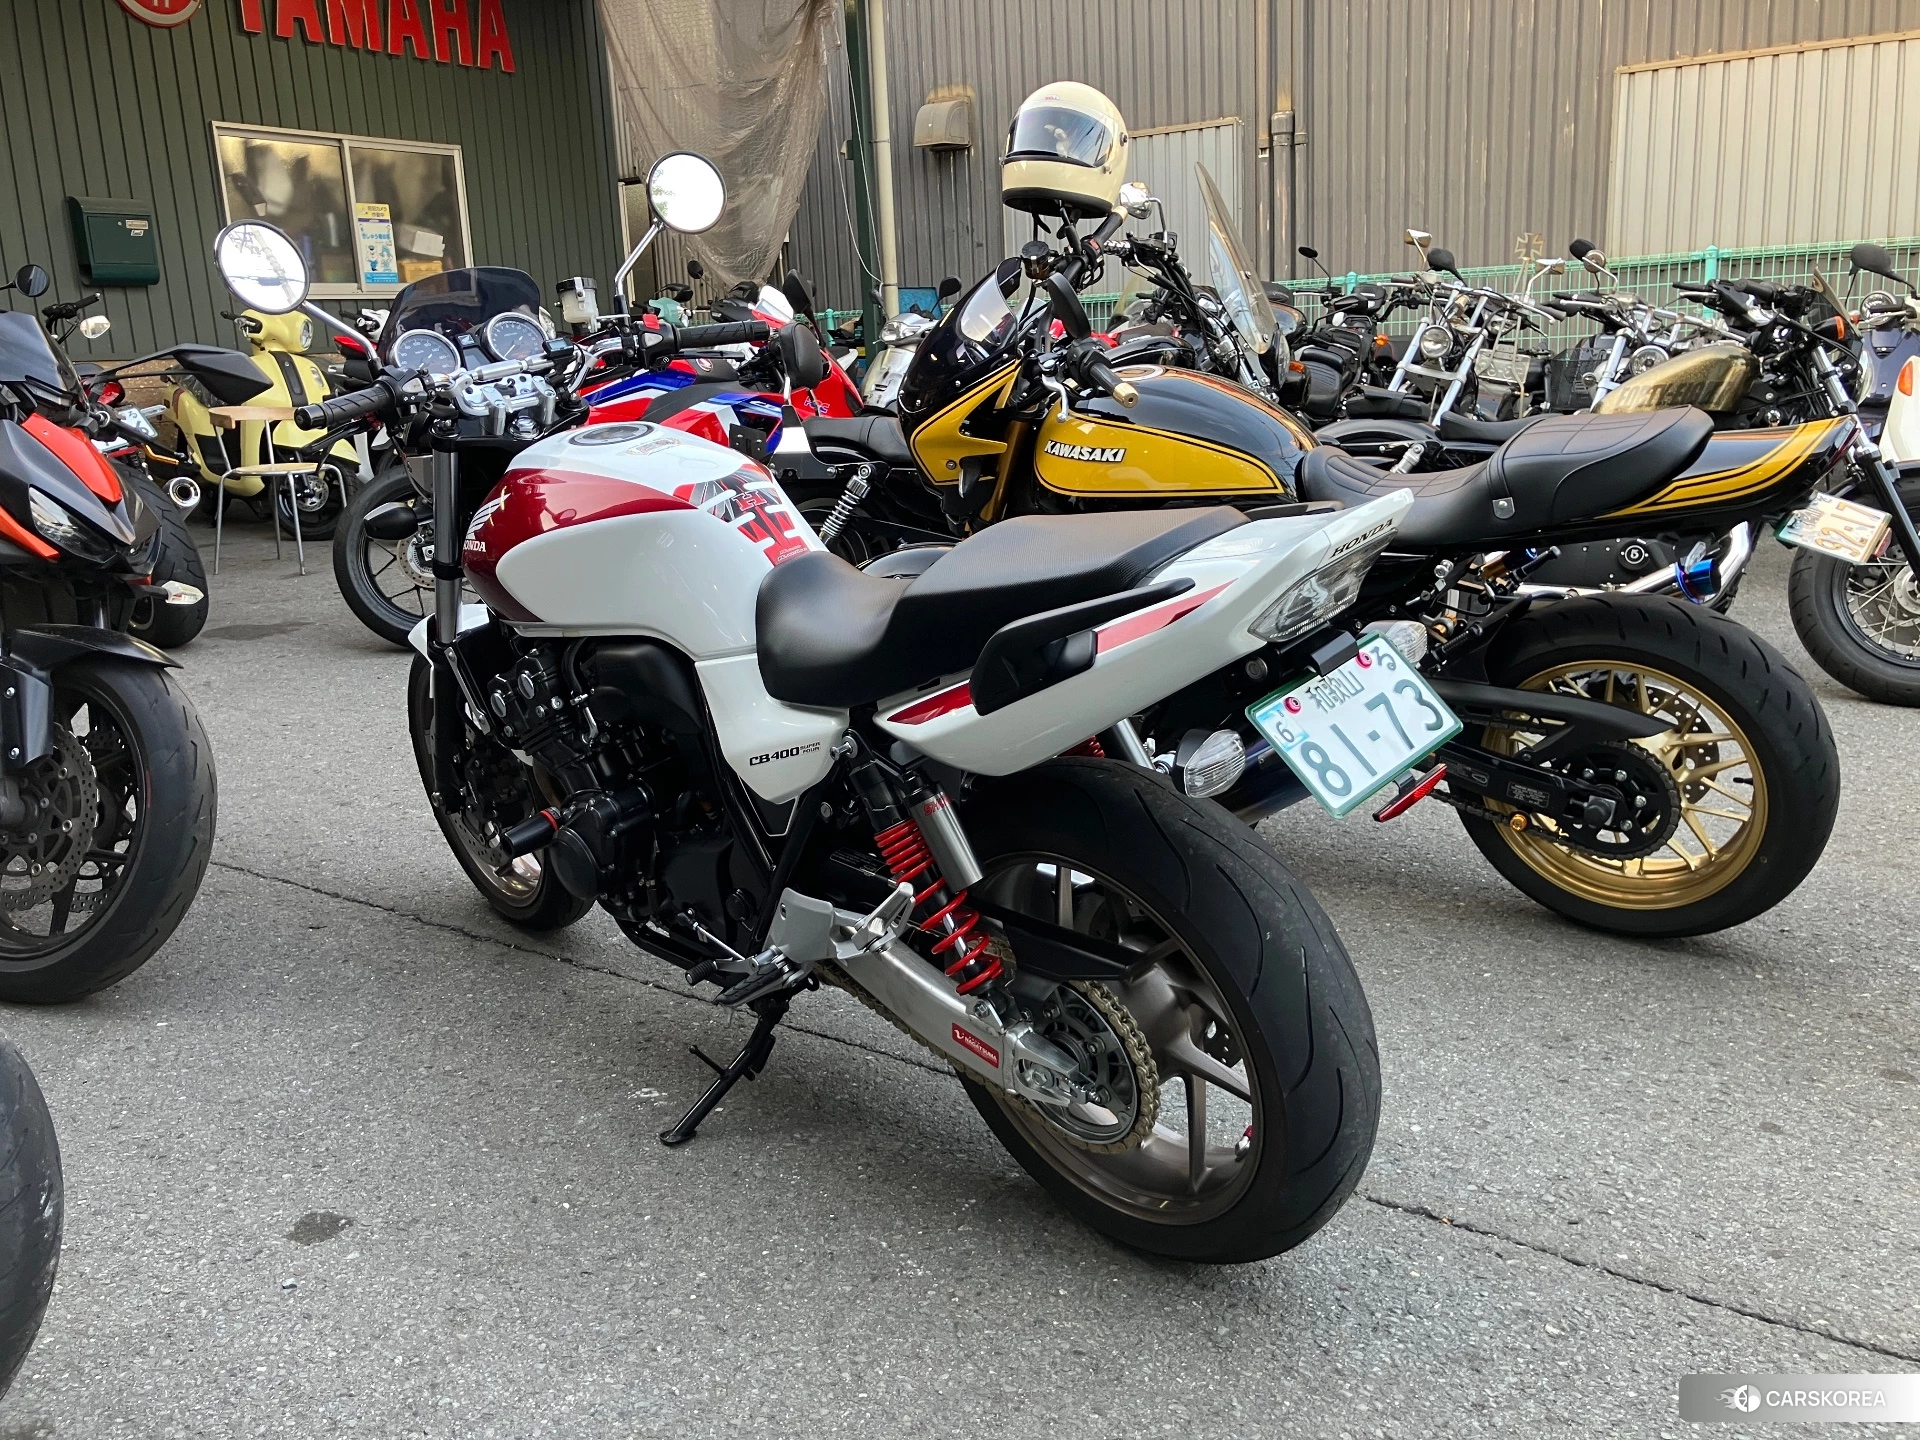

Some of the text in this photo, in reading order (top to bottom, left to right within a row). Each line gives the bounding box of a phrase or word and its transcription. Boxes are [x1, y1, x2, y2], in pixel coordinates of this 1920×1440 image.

[1044, 440, 1125, 462] KAWASAKI
[462, 540, 487, 552] ONDA
[1329, 517, 1394, 559] HONDA
[1630, 548, 1640, 559] 5
[1305, 645, 1397, 714] 和歌山 る
[1275, 720, 1295, 743] 6
[1300, 678, 1444, 797] 81-73
[749, 746, 800, 766] CB400
